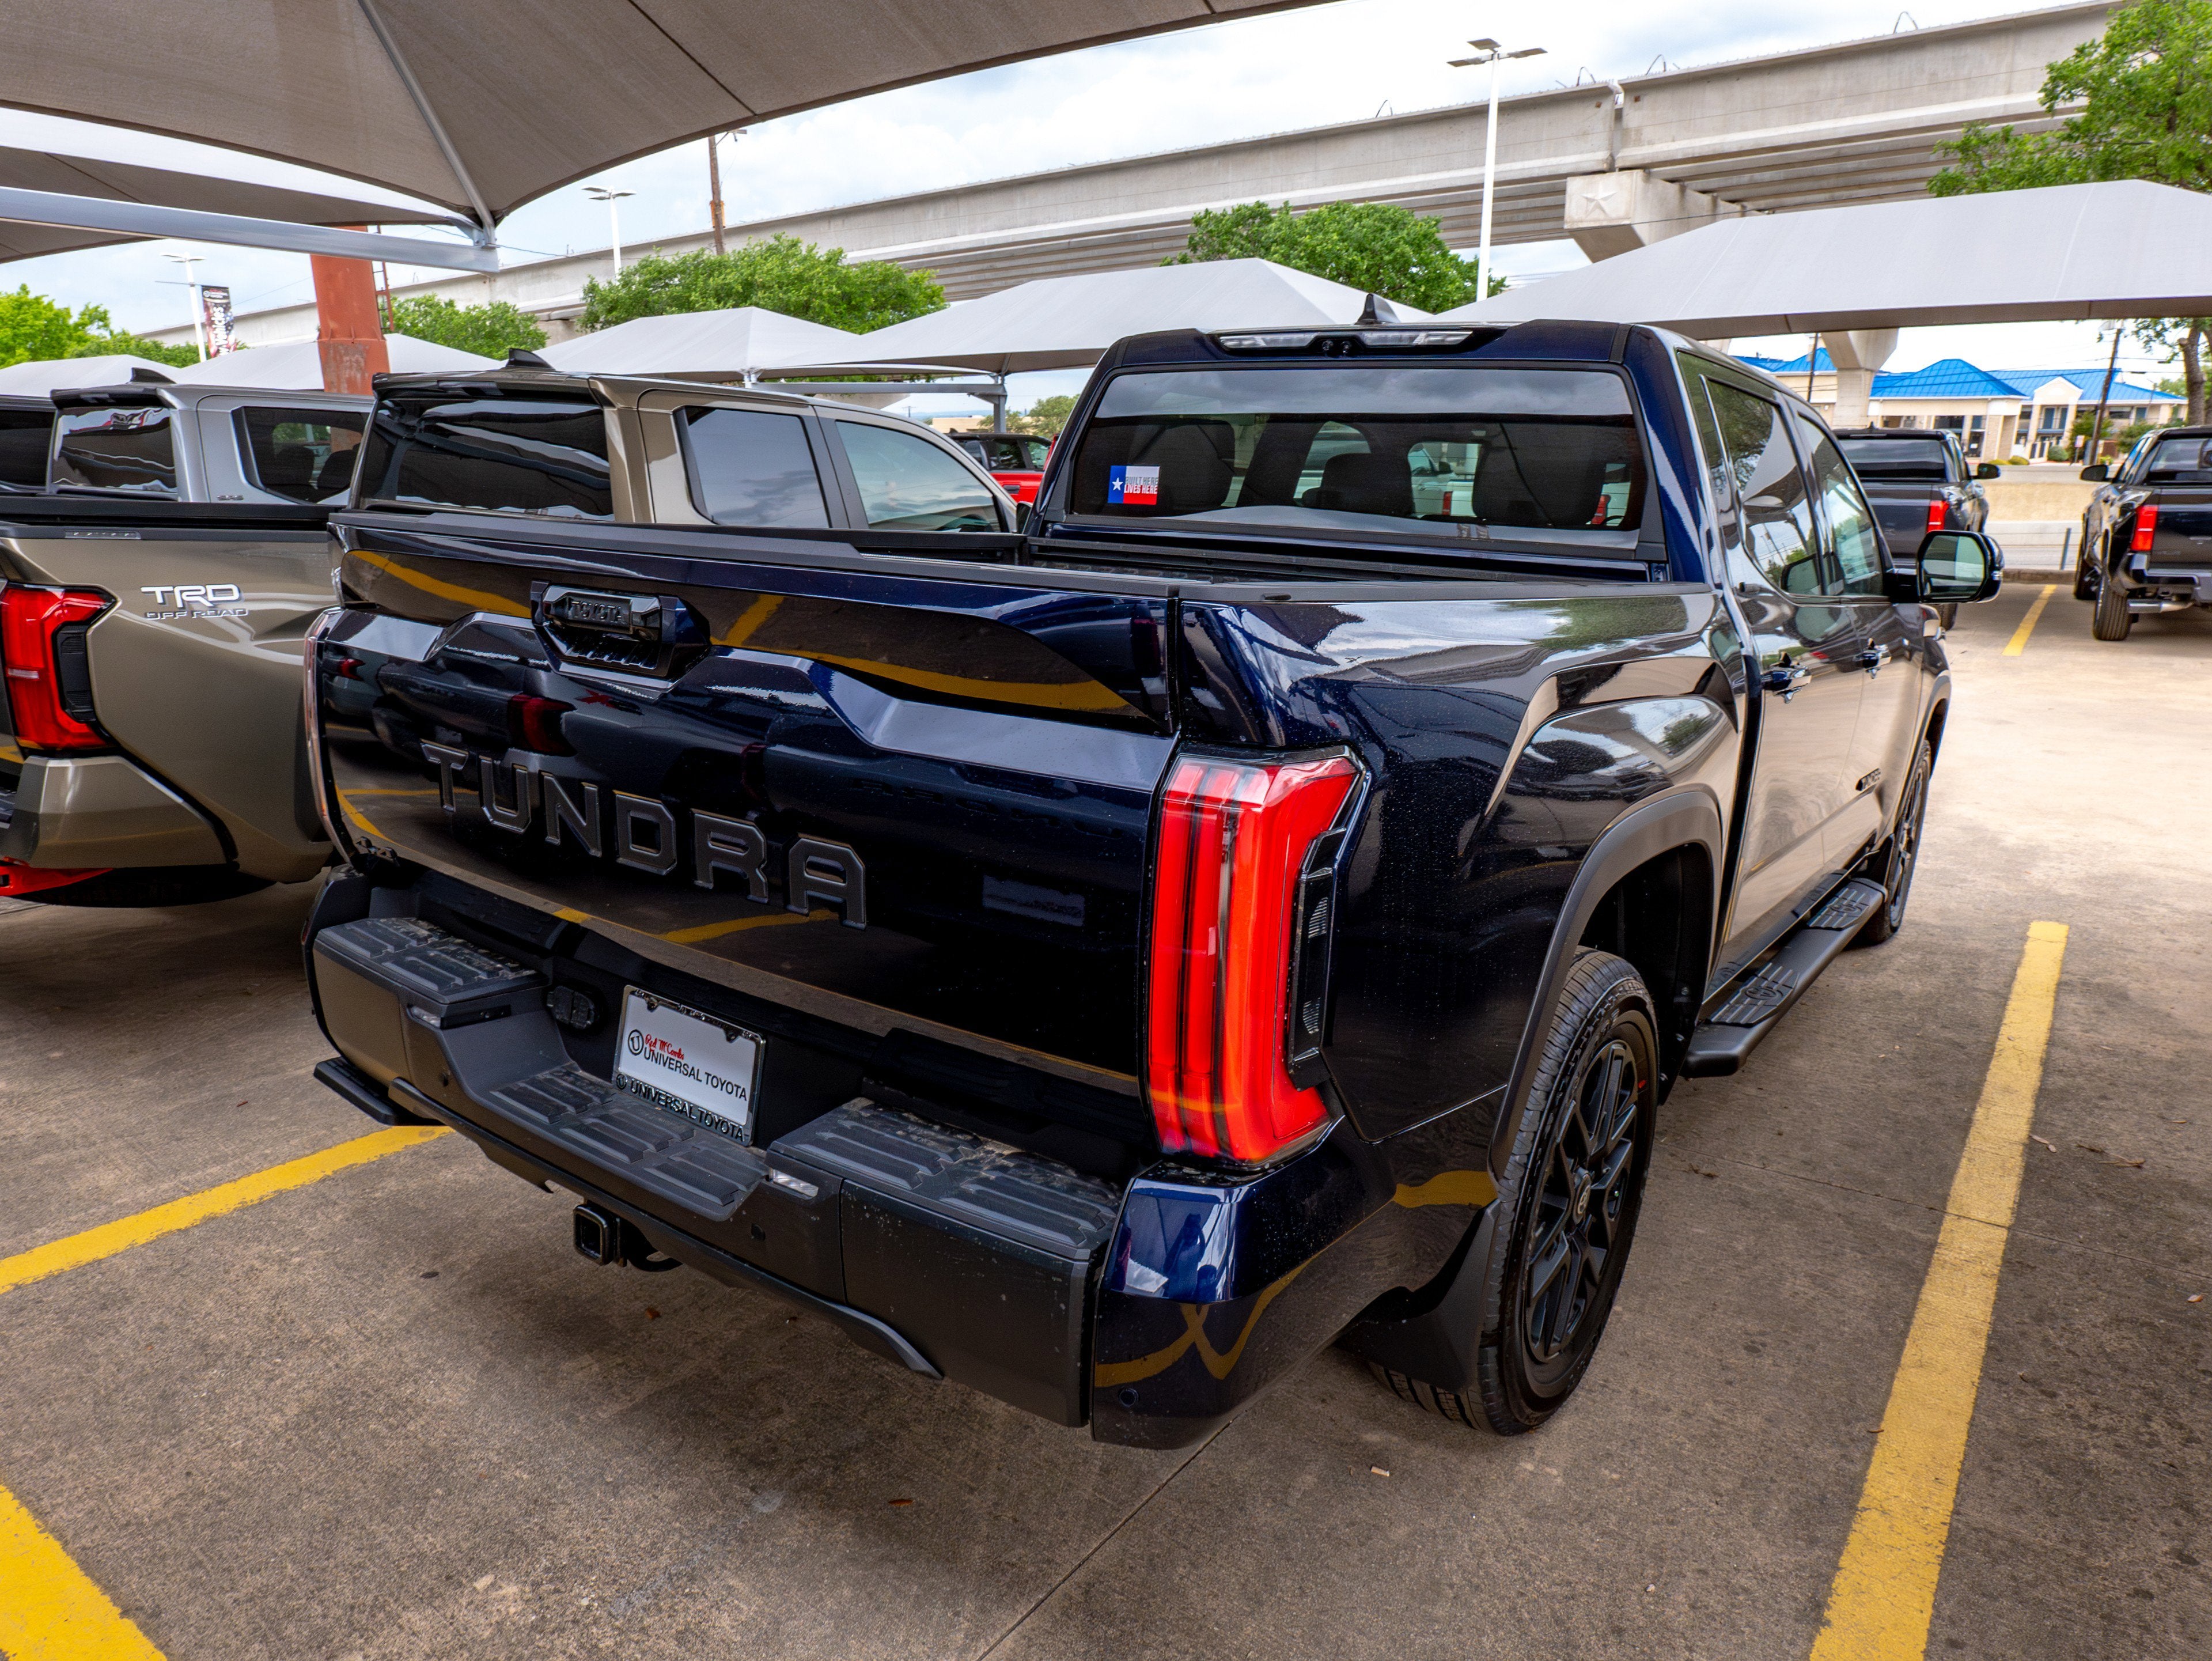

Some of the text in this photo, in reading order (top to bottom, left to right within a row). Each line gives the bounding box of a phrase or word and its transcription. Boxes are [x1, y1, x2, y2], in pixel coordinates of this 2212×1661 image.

[211, 307, 229, 346] Vehicles
[1124, 483, 1158, 494] LIVES HERE
[1125, 476, 1158, 485] BUILT HERE
[141, 584, 240, 608] TRD
[145, 608, 249, 620] OFF ROAD
[570, 600, 627, 625] TOYOTA
[419, 738, 866, 929] TUNDRA
[645, 1034, 658, 1052] Red
[643, 1047, 747, 1102] UNIVERSAL TOYOTA
[630, 1078, 745, 1142] UNIVERSAL TOYOTA
